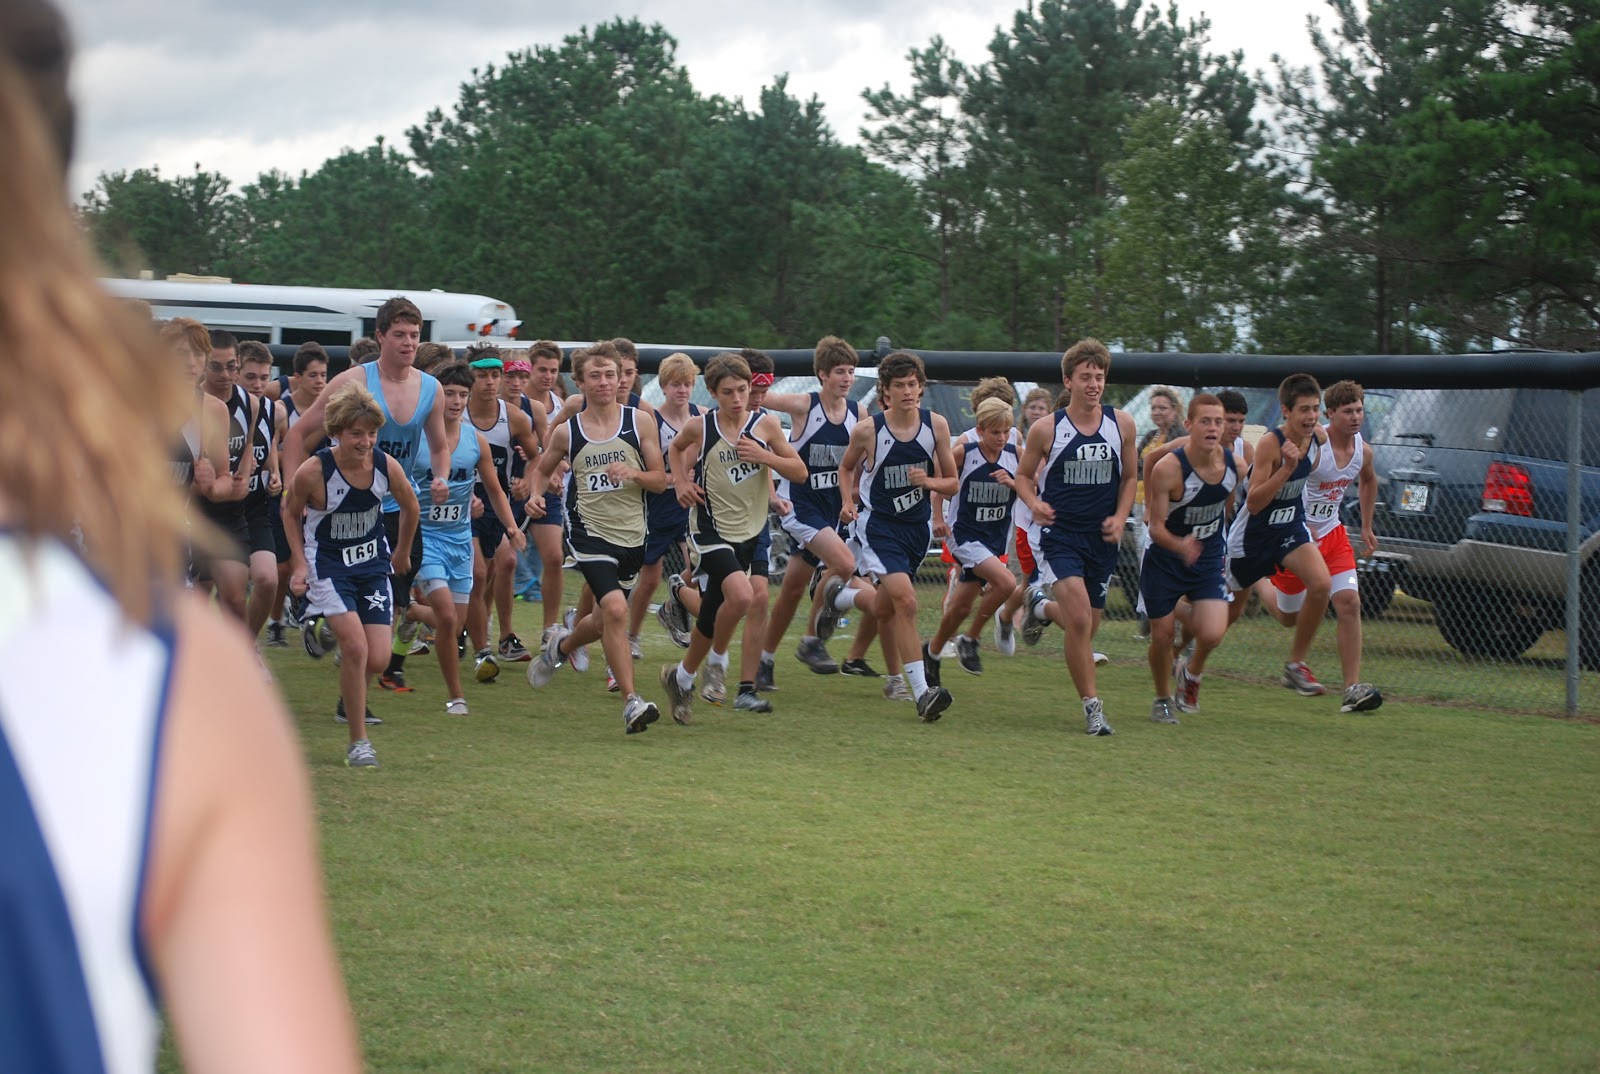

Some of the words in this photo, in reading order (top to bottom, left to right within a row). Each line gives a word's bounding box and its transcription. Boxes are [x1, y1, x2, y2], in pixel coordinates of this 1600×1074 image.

[378, 440, 412, 459] SGA
[1080, 444, 1108, 460] 173
[585, 450, 626, 468] RAIDERS
[730, 461, 760, 483] 284
[813, 472, 838, 489] 170
[1063, 460, 1113, 485] STRATFORD
[897, 488, 921, 511] 178
[967, 481, 1010, 503] STRATFORD
[432, 506, 460, 520] 313
[980, 507, 1004, 521] 180
[1272, 508, 1294, 523] 177
[1311, 504, 1334, 518] 146
[346, 542, 375, 565] 169
